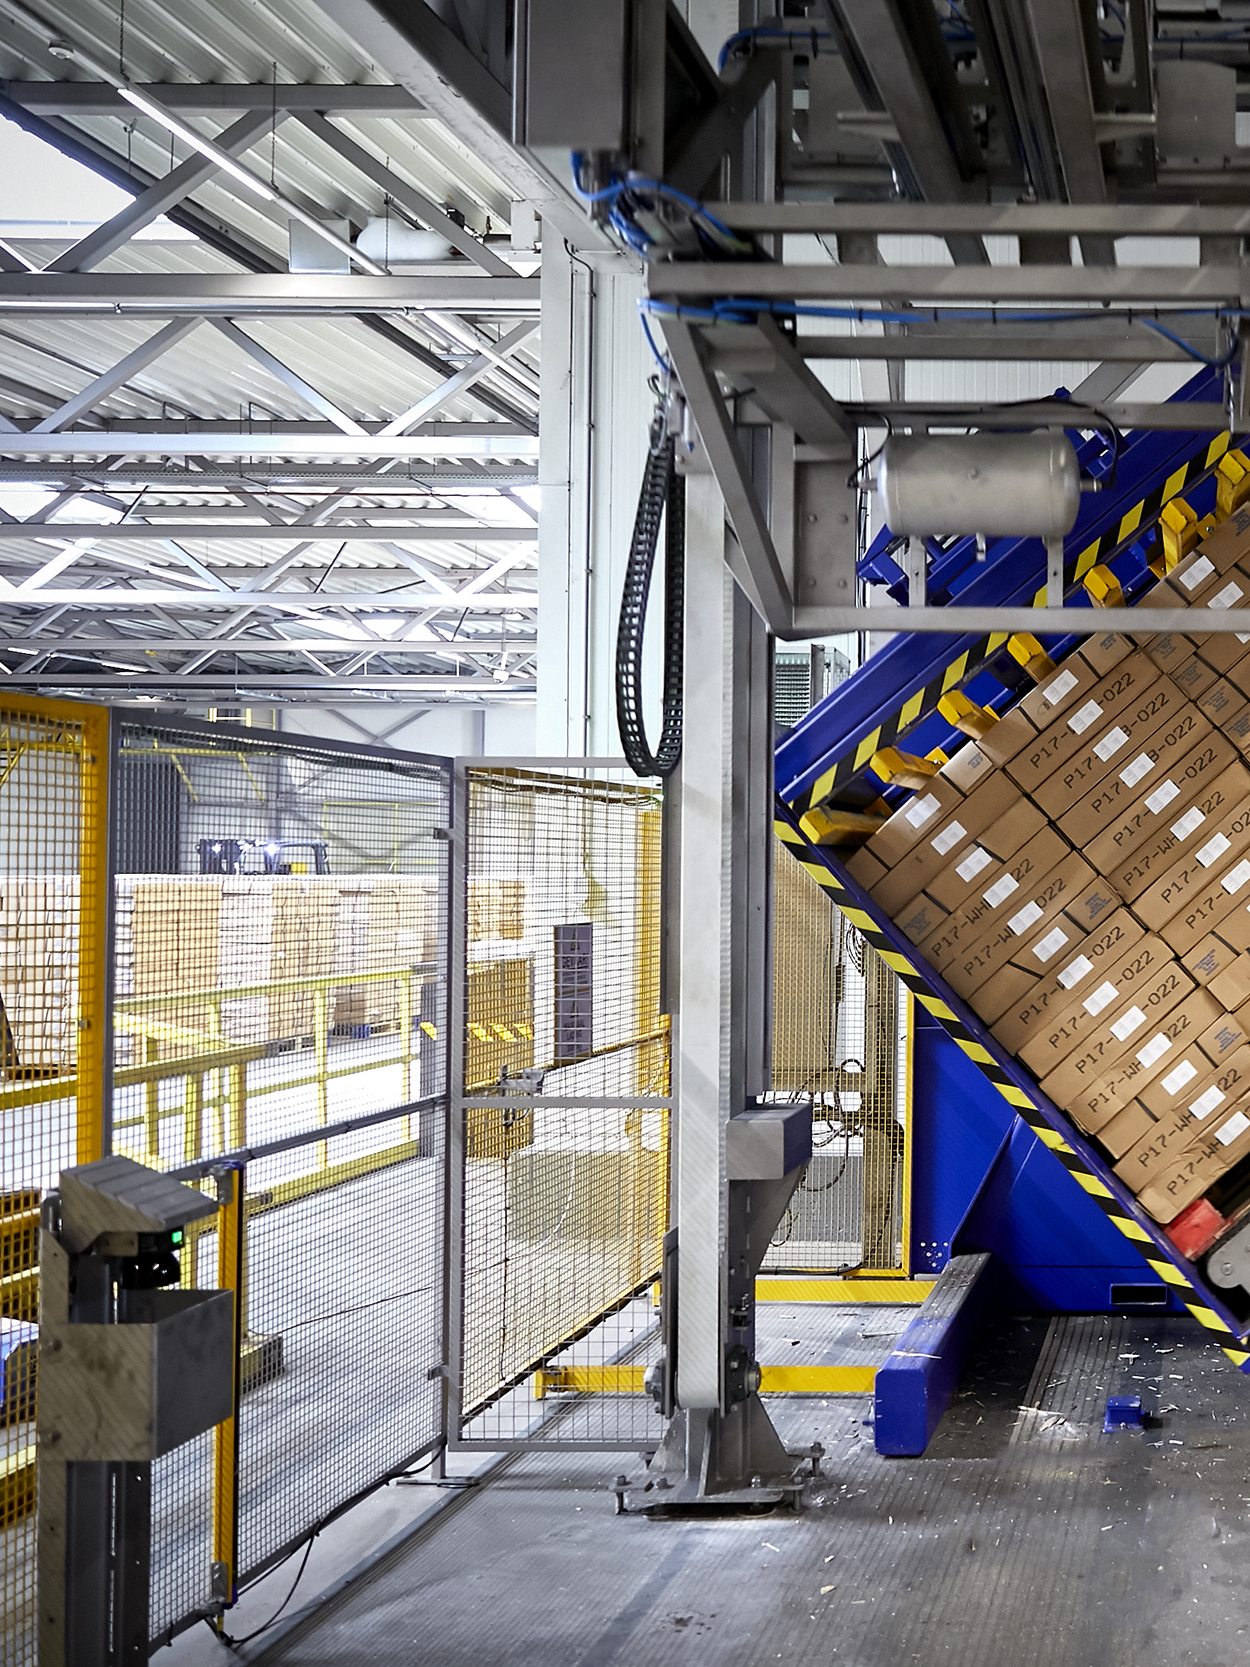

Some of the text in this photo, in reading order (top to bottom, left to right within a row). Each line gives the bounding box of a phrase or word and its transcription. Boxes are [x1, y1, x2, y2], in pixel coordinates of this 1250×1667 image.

[1029, 673, 1136, 768] P17--022
[1063, 692, 1171, 789] P17-B-022
[1091, 716, 1198, 813] P17B-022
[1112, 748, 1219, 847] P17--022
[1122, 791, 1226, 886] P17-WH22
[931, 858, 1035, 957] P17-WH22
[963, 878, 1068, 976] P17-W022
[1019, 926, 1126, 1025] P17--022
[1048, 951, 1155, 1049] P17--022
[1075, 975, 1181, 1074] P17--022
[1088, 1015, 1192, 1113] P17-WH22
[1137, 1068, 1243, 1167] P17-WH22
